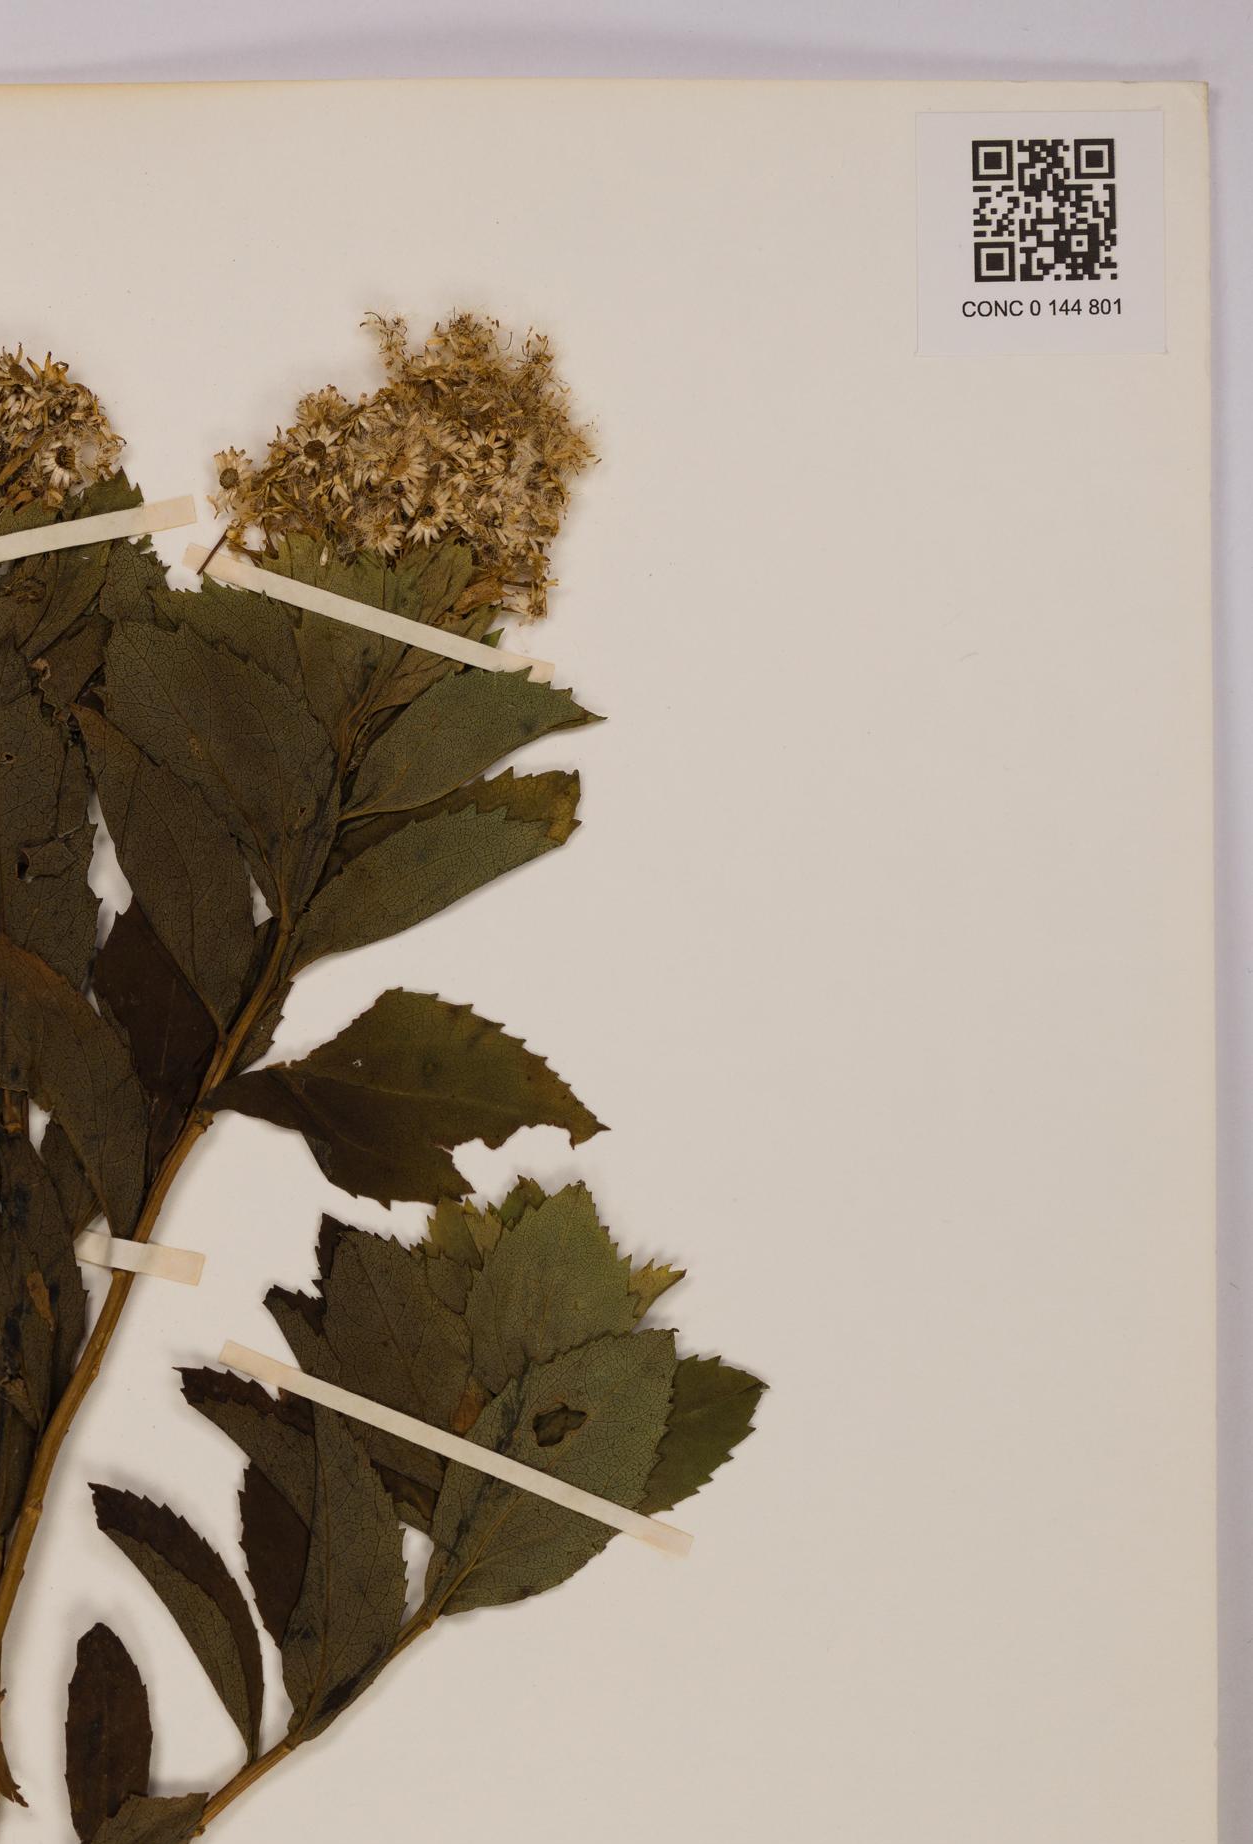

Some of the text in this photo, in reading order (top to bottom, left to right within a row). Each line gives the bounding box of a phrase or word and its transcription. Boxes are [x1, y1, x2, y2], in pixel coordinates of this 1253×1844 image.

[962, 297, 1121, 318] CONC 0 144 801
